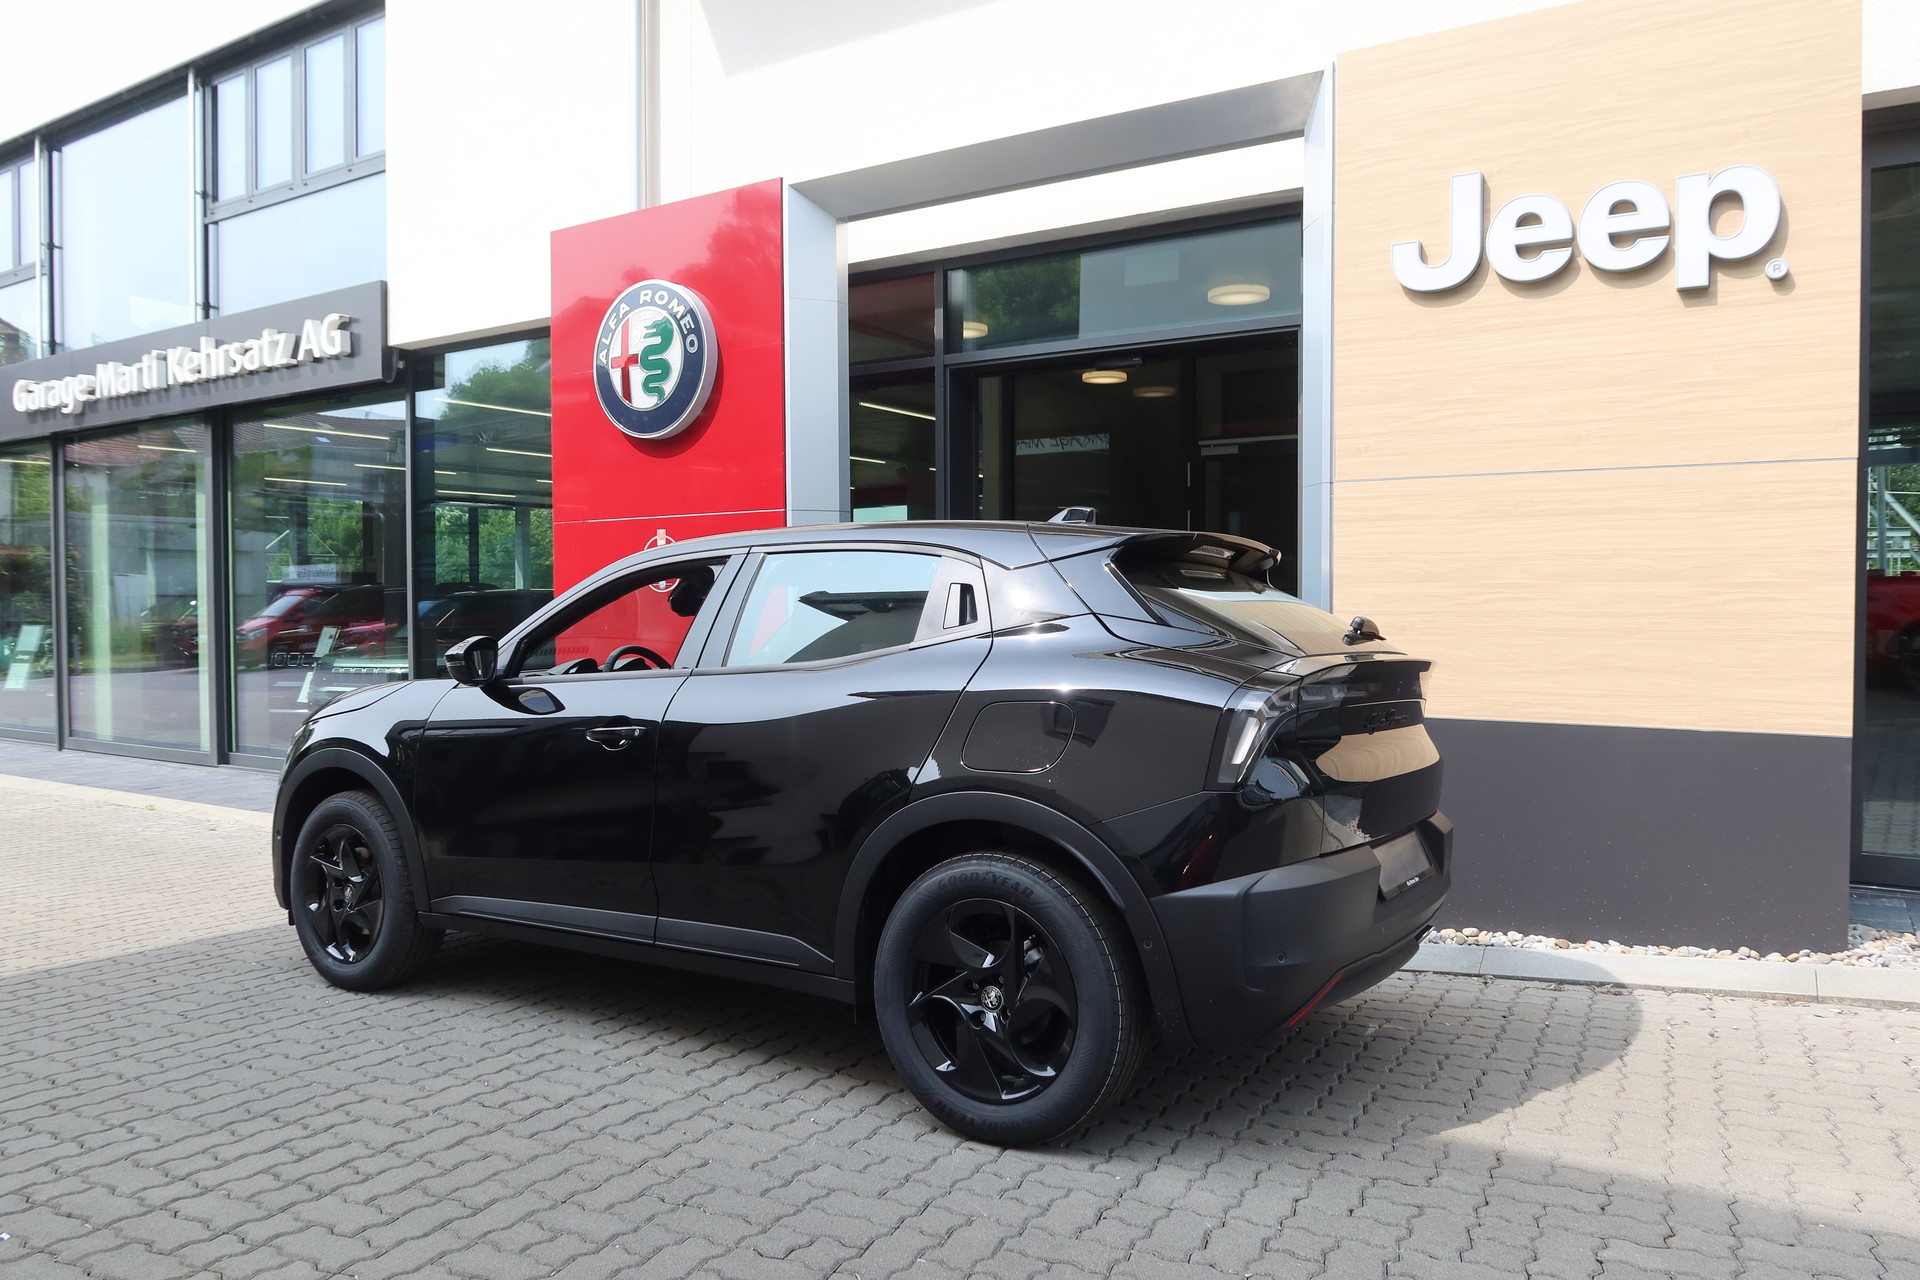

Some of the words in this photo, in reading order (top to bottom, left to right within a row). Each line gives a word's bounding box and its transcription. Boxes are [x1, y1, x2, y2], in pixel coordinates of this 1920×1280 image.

[1391, 164, 1782, 292] Jeep
[13, 374, 95, 414] Garage
[95, 349, 167, 400] Marti
[167, 328, 296, 386] Kehrsatz
[298, 313, 350, 361] AG
[599, 303, 631, 364] ALFA
[639, 289, 699, 354] ROMEO
